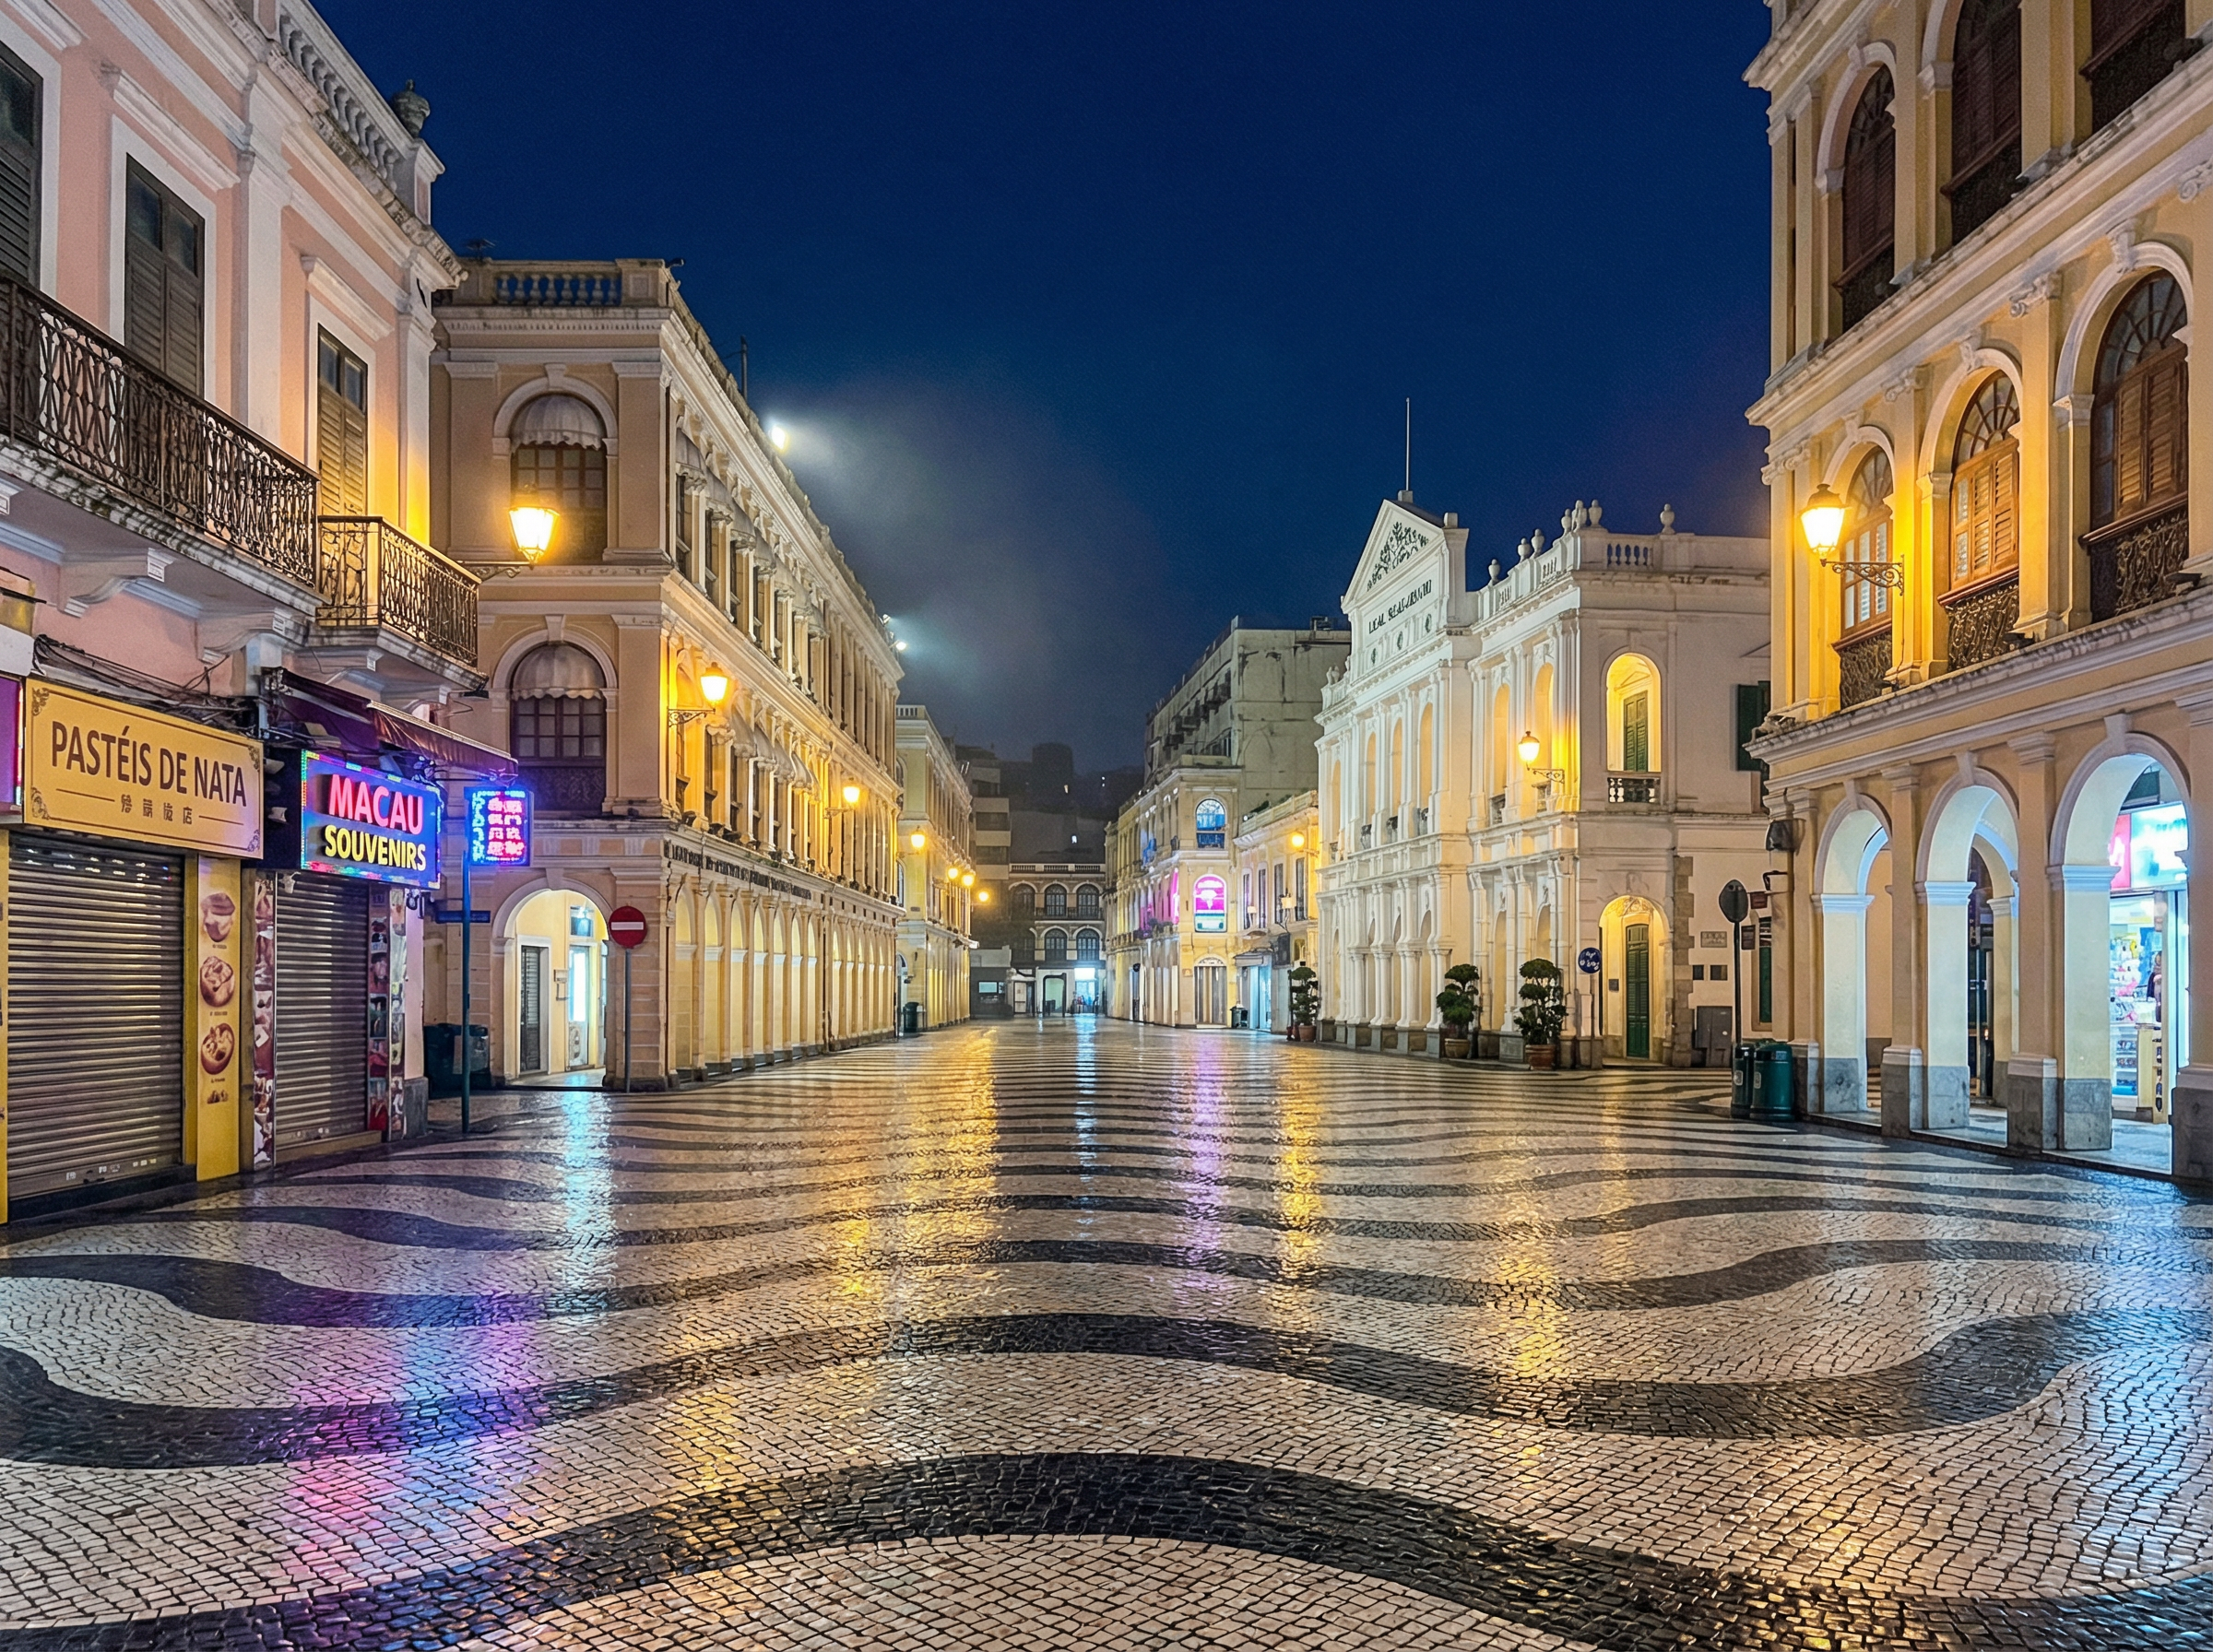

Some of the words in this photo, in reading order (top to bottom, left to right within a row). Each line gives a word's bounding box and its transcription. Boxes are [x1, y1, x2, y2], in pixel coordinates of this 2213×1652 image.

[52, 721, 152, 786] PASTÉIS
[160, 748, 187, 795] DE
[195, 756, 247, 807] NATA
[328, 774, 423, 835] MACAU
[325, 824, 426, 871] SOUVENIRS
